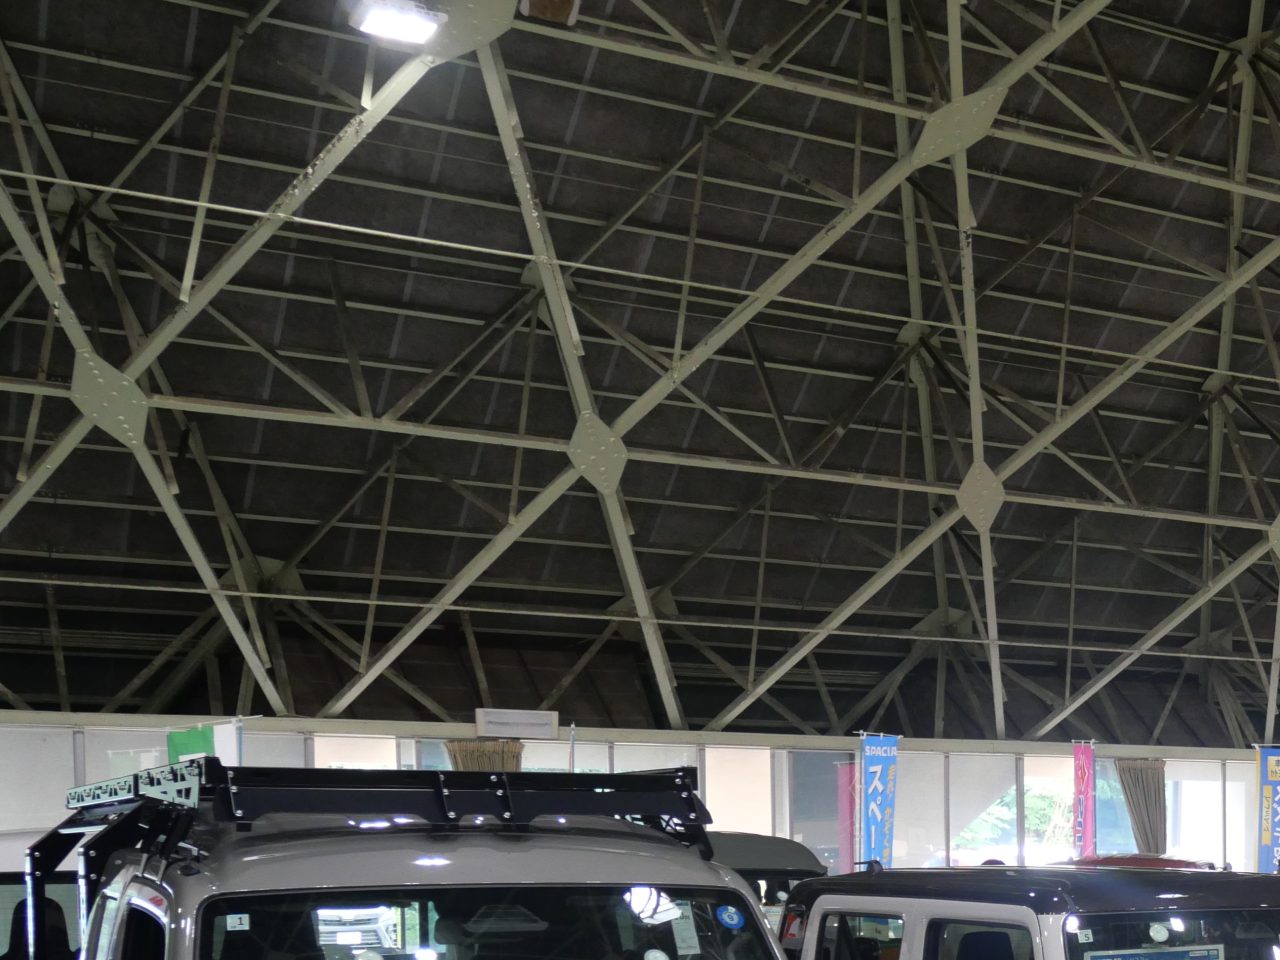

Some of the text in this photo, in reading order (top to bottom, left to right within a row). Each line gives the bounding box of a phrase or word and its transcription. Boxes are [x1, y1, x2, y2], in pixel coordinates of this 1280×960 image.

[865, 745, 897, 757] SPACIA
[237, 916, 244, 926] 1
[1084, 933, 1090, 941] 5
